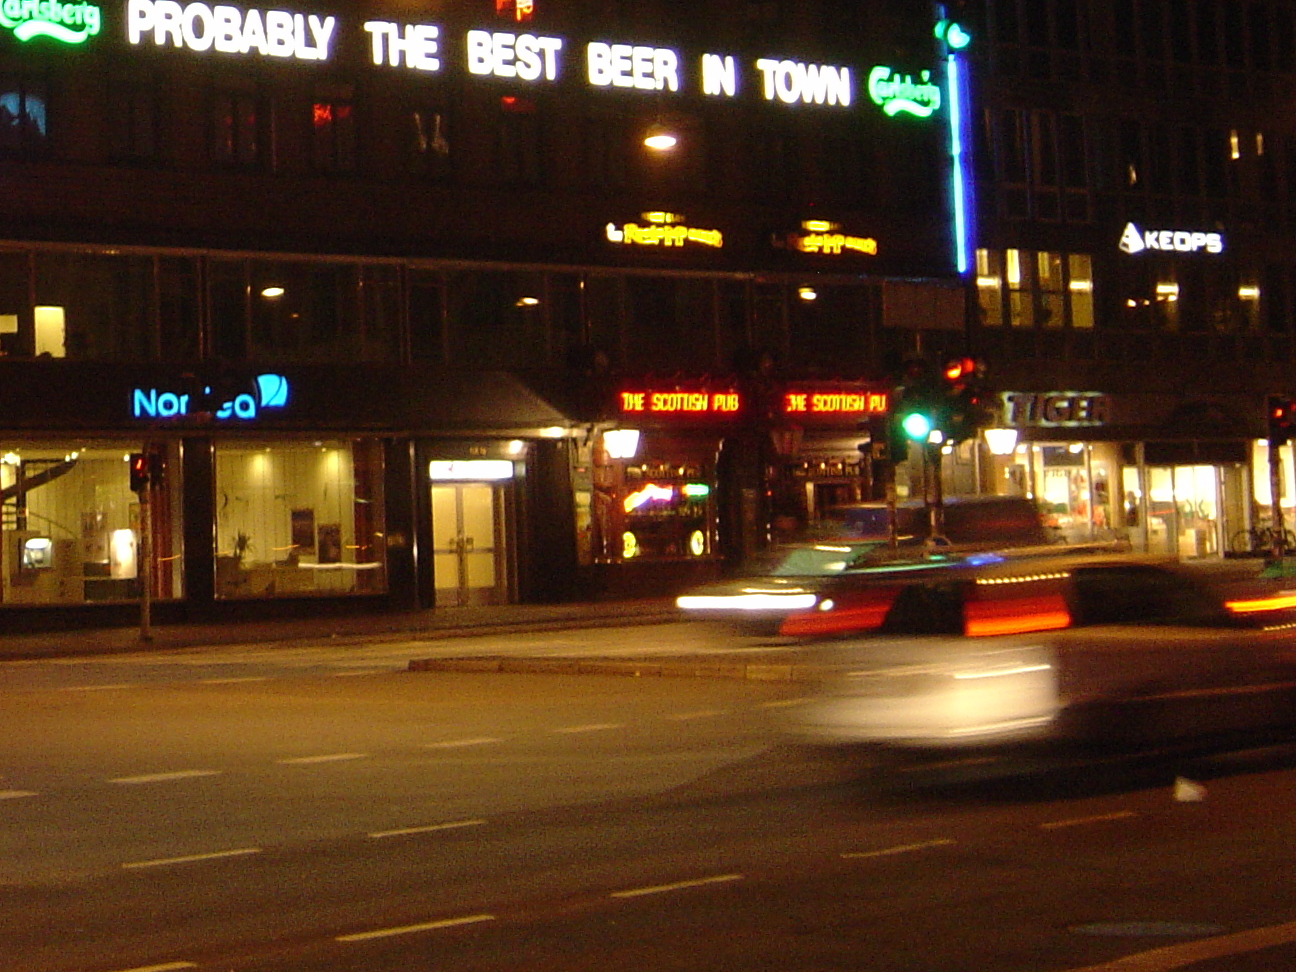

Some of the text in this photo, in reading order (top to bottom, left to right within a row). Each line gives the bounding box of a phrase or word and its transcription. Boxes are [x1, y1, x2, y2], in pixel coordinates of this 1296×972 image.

[364, 21, 440, 71] THE
[467, 30, 561, 82] BEST
[588, 41, 678, 92] BEER
[702, 54, 735, 96] IN
[757, 59, 851, 107] TOWN
[868, 65, 941, 117] Carlsberg
[1145, 230, 1223, 253] KEOPS
[133, 388, 256, 419] Norea
[622, 393, 645, 411] THE
[713, 394, 739, 411] PUB
[868, 395, 887, 412] PU
